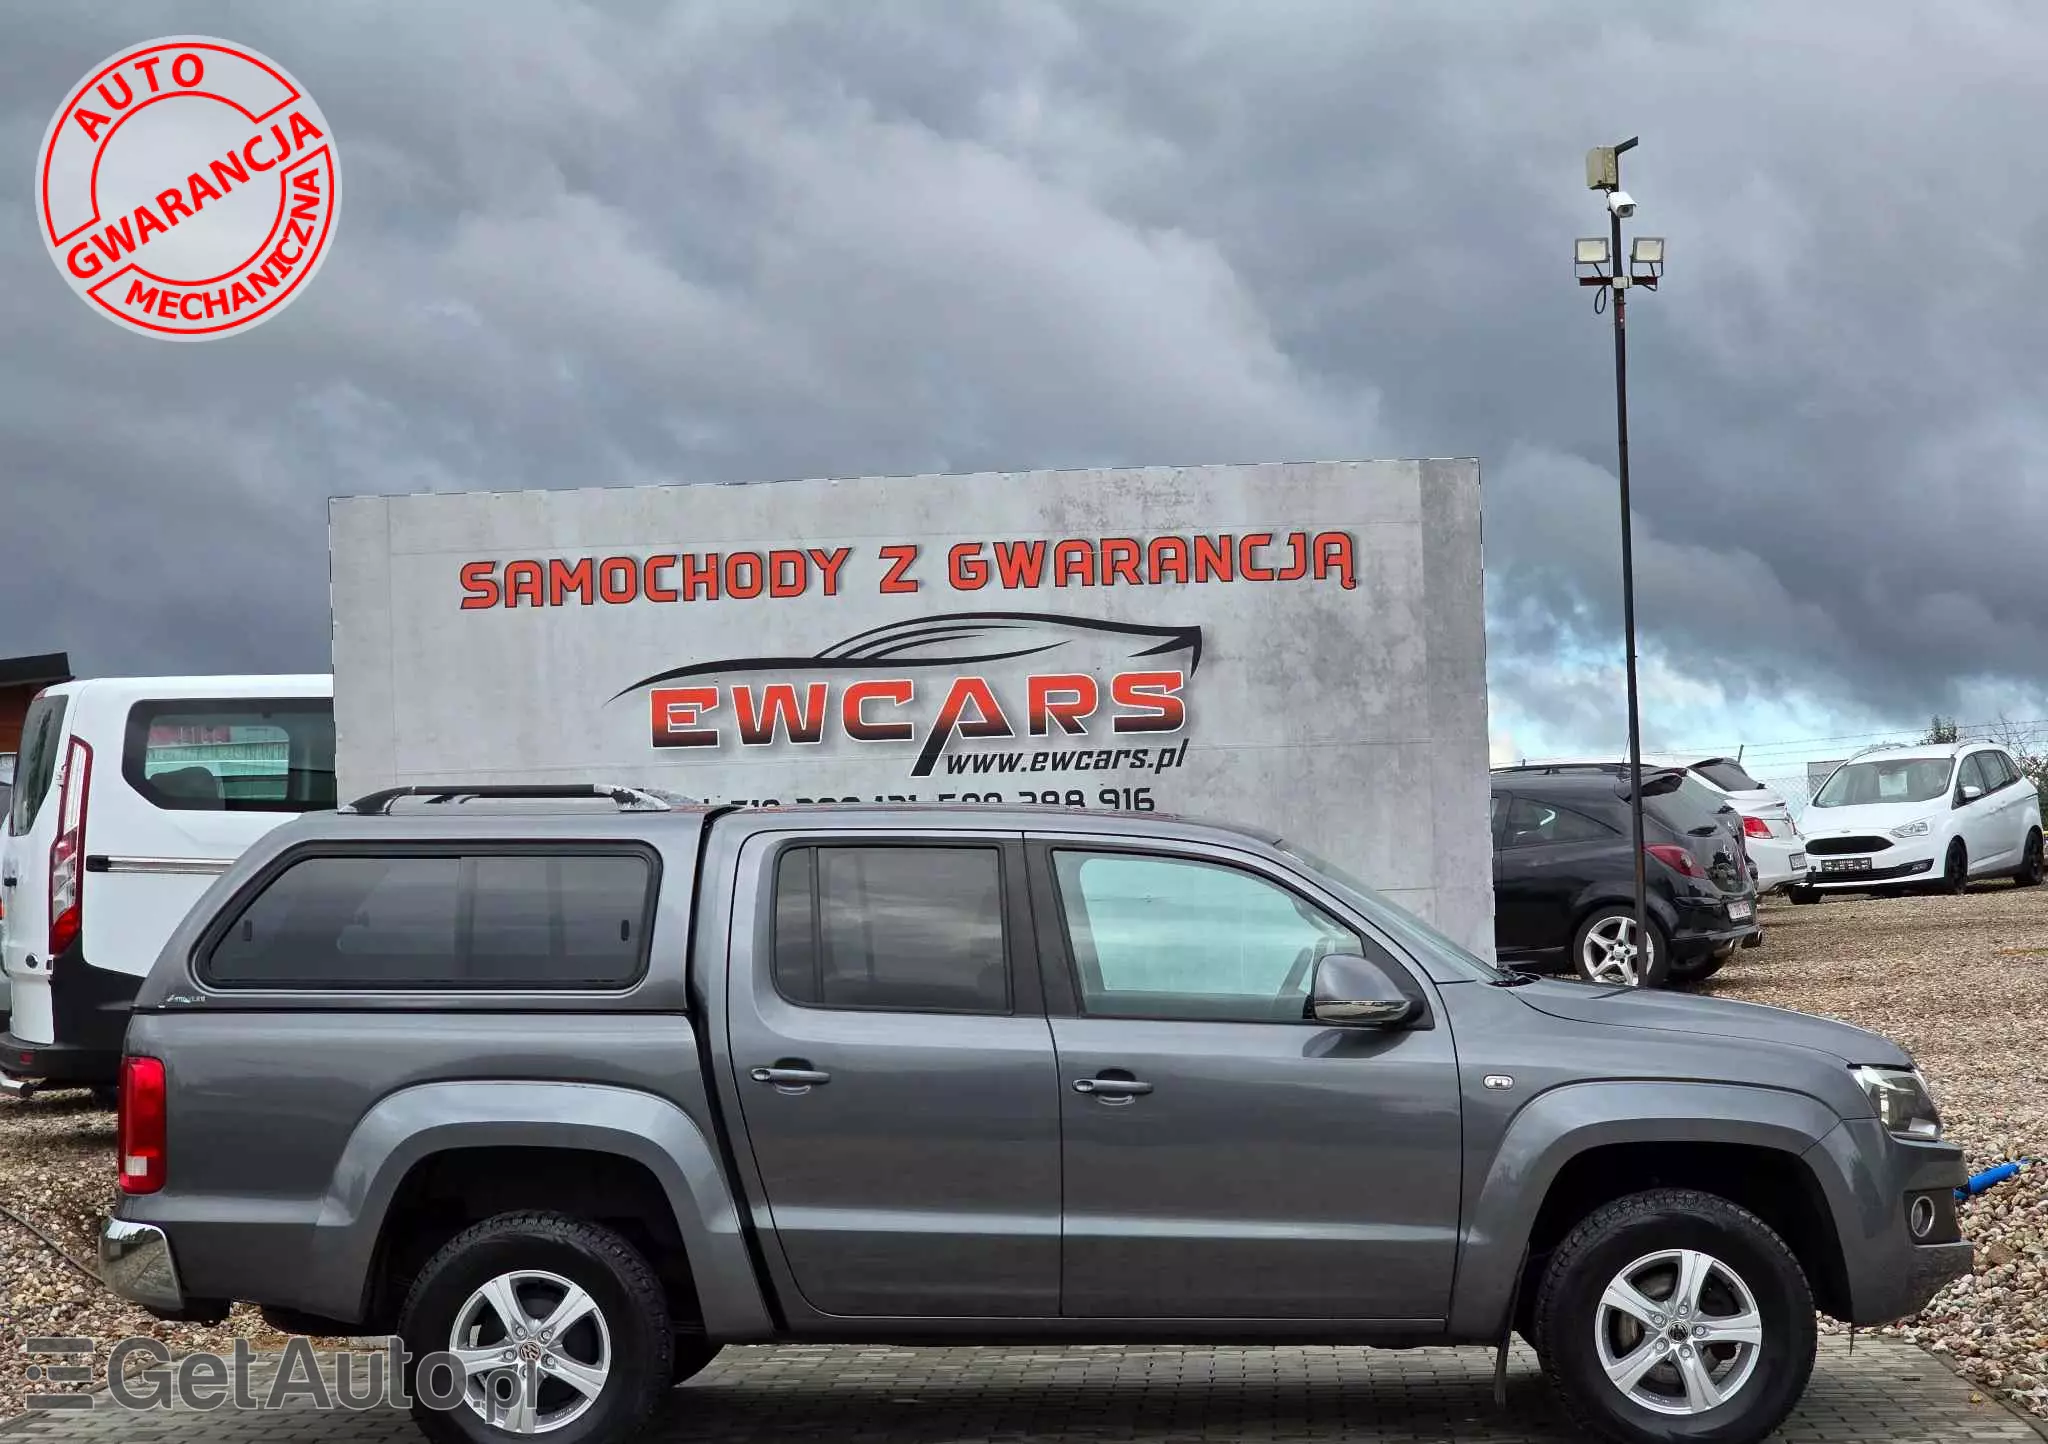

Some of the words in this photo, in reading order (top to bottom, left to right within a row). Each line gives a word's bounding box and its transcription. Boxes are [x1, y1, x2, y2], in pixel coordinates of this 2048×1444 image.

[459, 546, 854, 610] SAMOCHODY
[878, 544, 920, 594] Z
[947, 531, 1358, 591] GWARANCJĄ
[649, 669, 1187, 778] EWCARS
[946, 737, 1190, 775] www.ewcars.pl
[1098, 787, 1155, 812] 916
